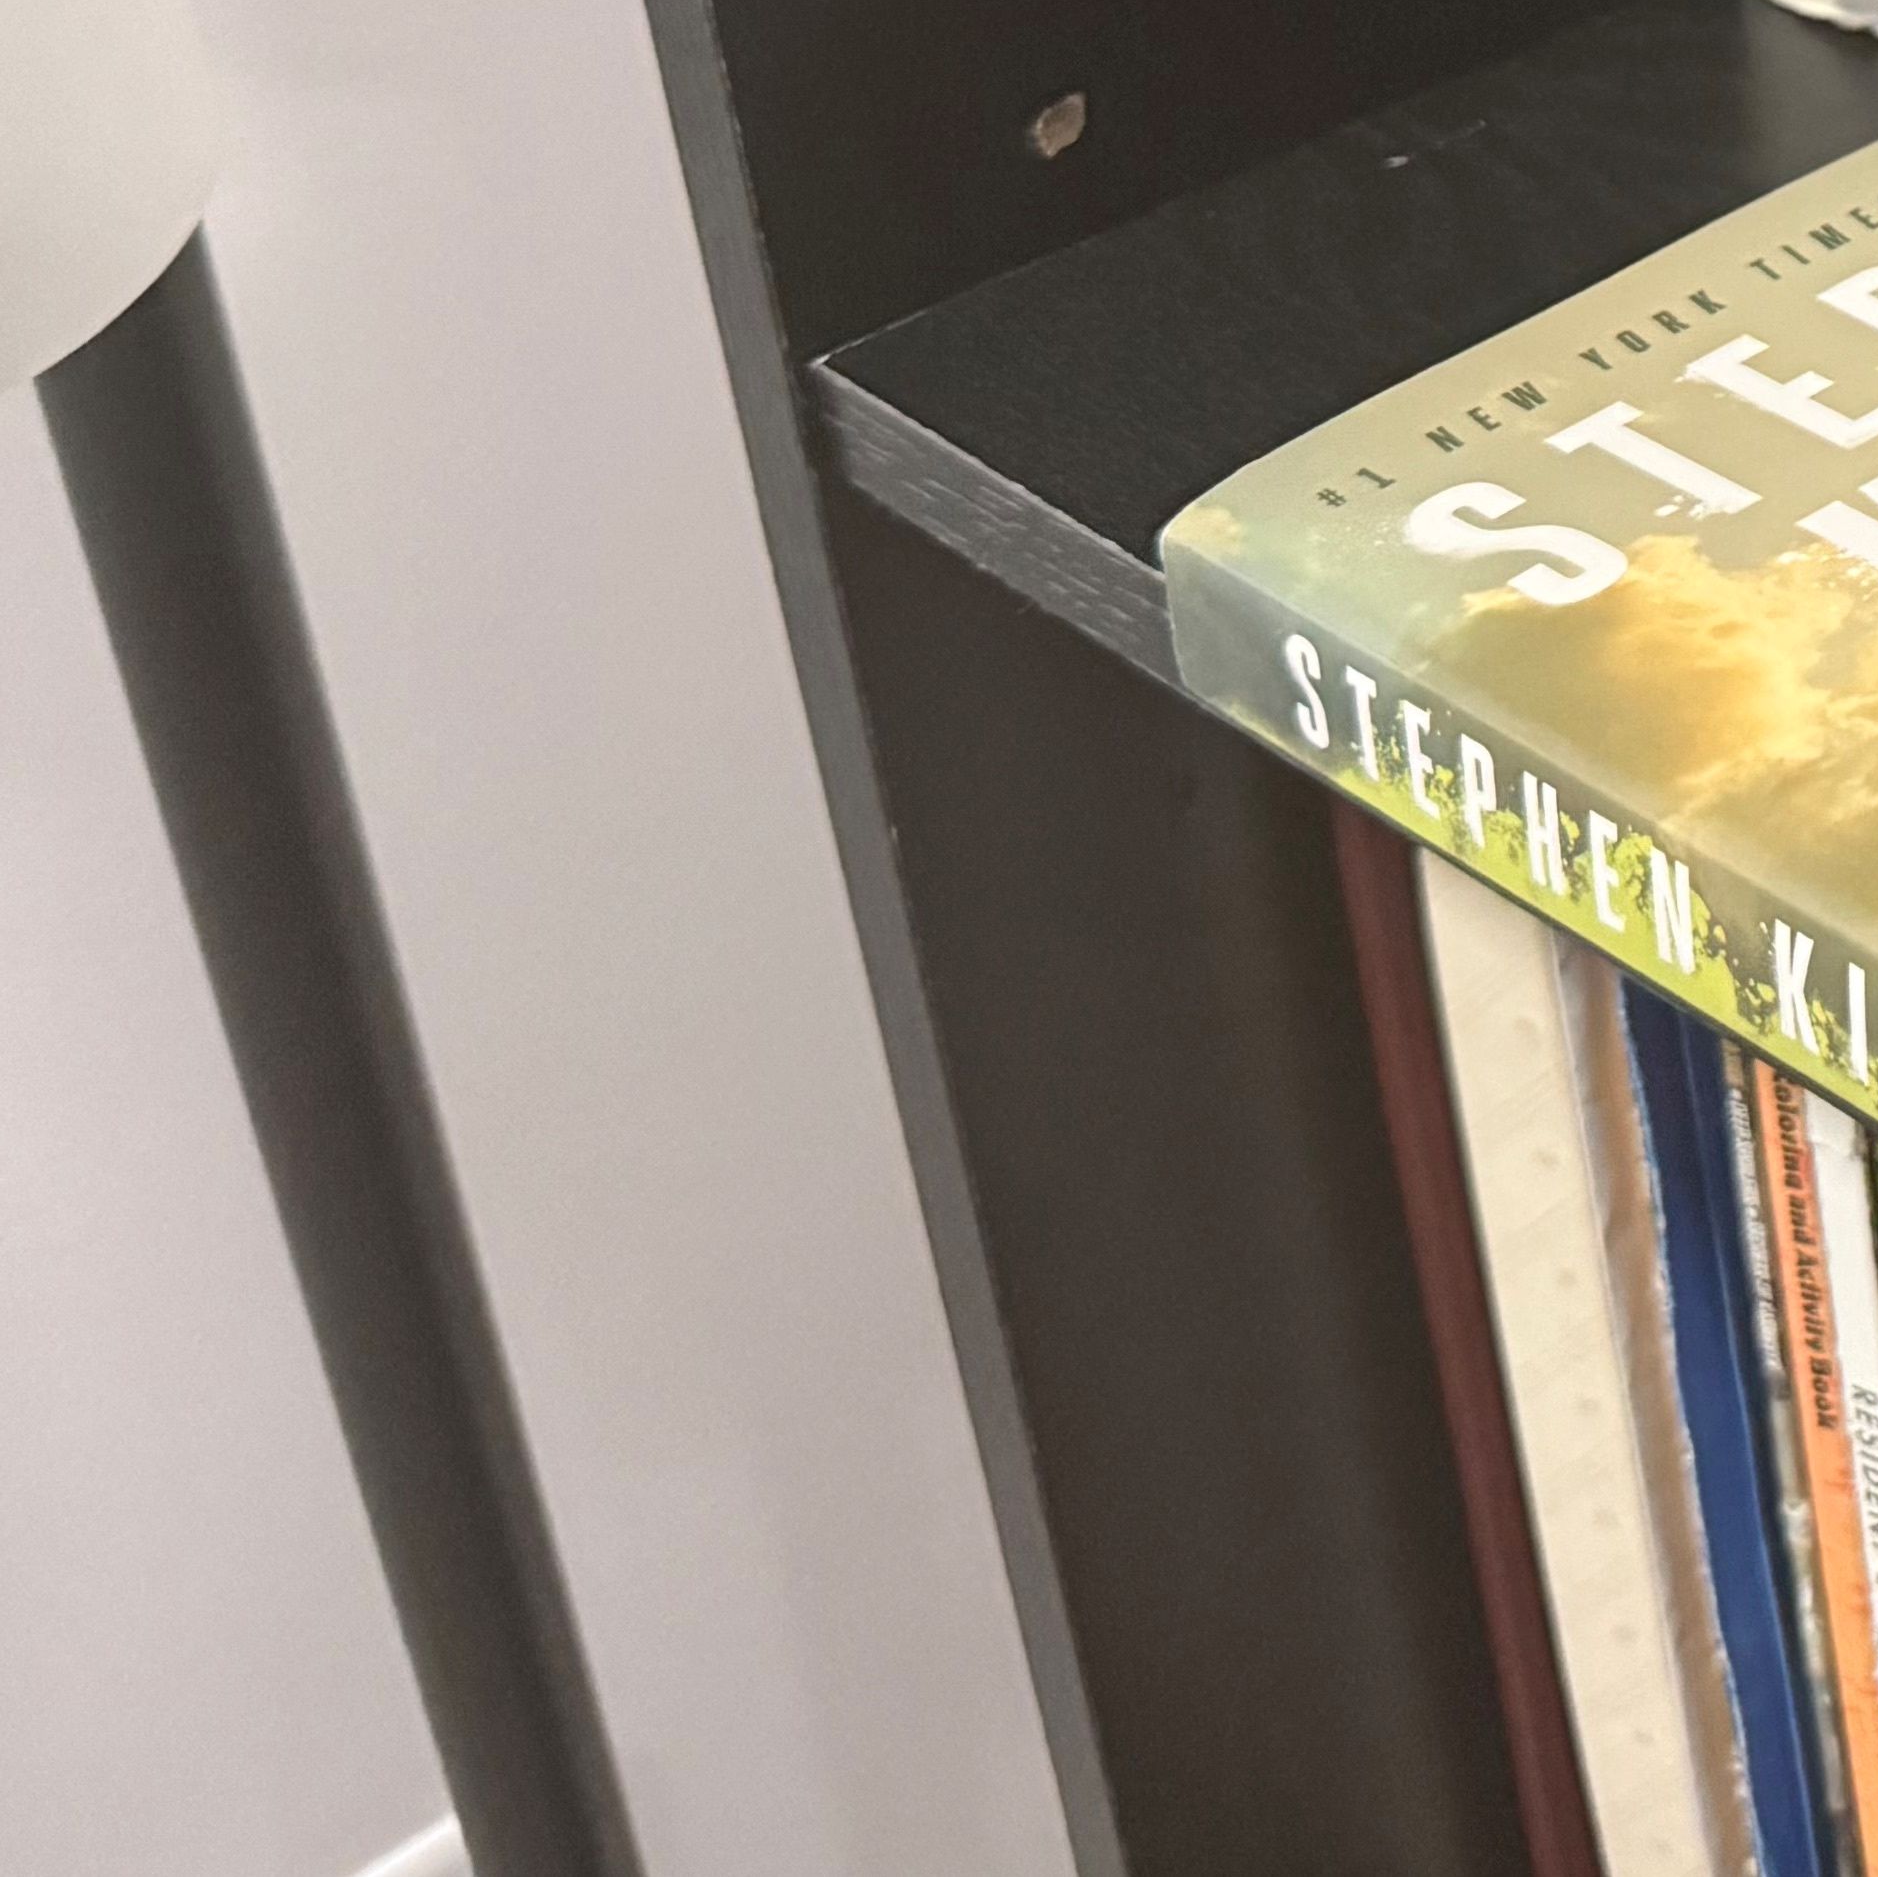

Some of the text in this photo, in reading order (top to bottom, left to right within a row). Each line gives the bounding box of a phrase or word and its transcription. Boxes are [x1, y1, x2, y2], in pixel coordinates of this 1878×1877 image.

[1314, 466, 1397, 510] #1
[1424, 380, 1547, 454] NEW
[1578, 289, 1727, 373] YORK
[1283, 632, 1697, 975] STEPHEN
[1772, 1072, 1804, 1190] oloring
